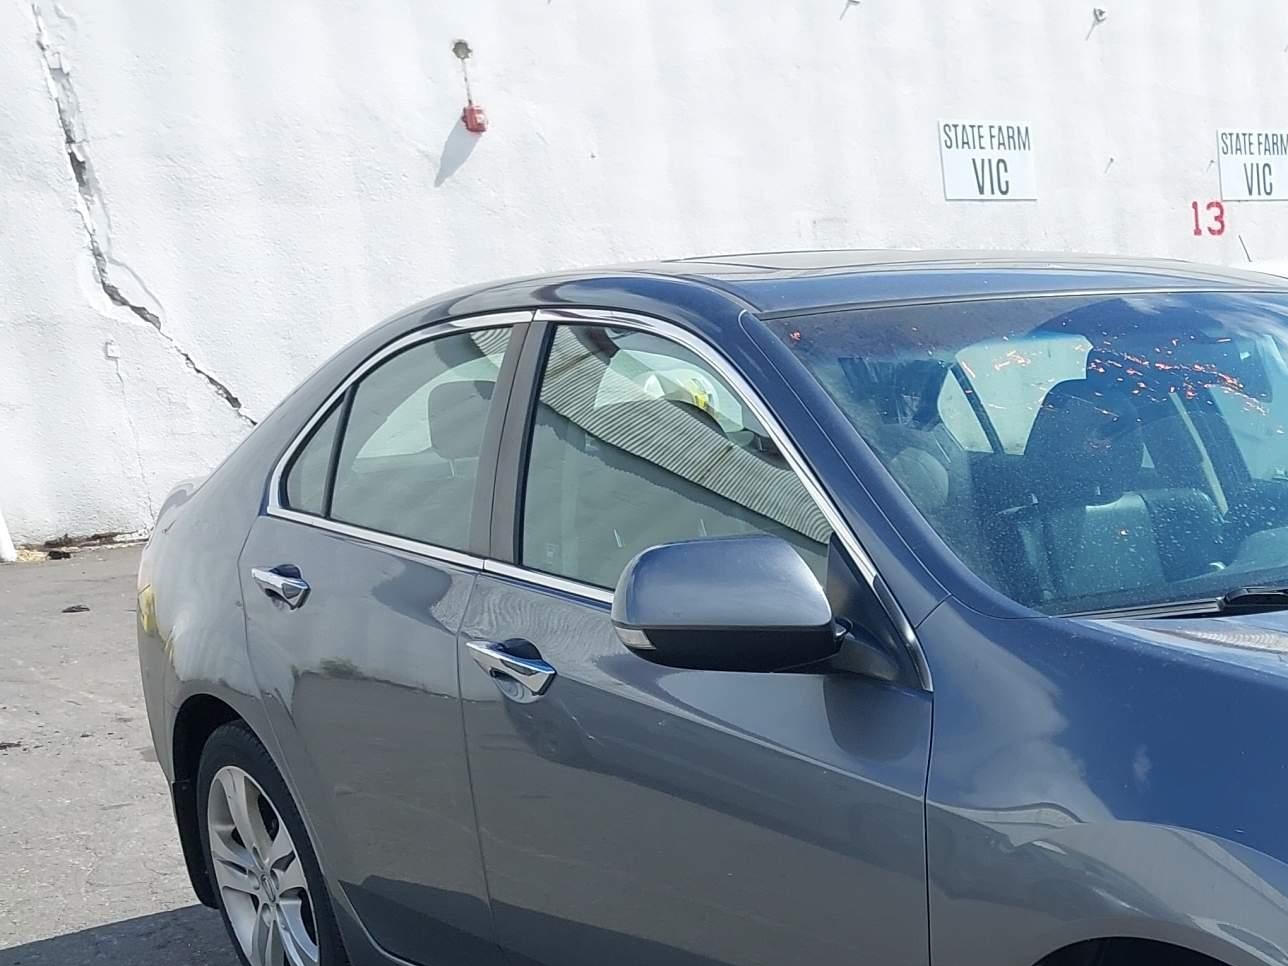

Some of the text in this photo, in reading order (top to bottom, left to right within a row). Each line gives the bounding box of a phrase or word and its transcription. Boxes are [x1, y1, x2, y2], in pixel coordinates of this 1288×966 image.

[943, 123, 1031, 151] STATE FARM
[1220, 132, 1255, 156] STATE
[971, 157, 1010, 196] VIC
[1243, 162, 1273, 196] VIC
[1191, 200, 1226, 237] 13
